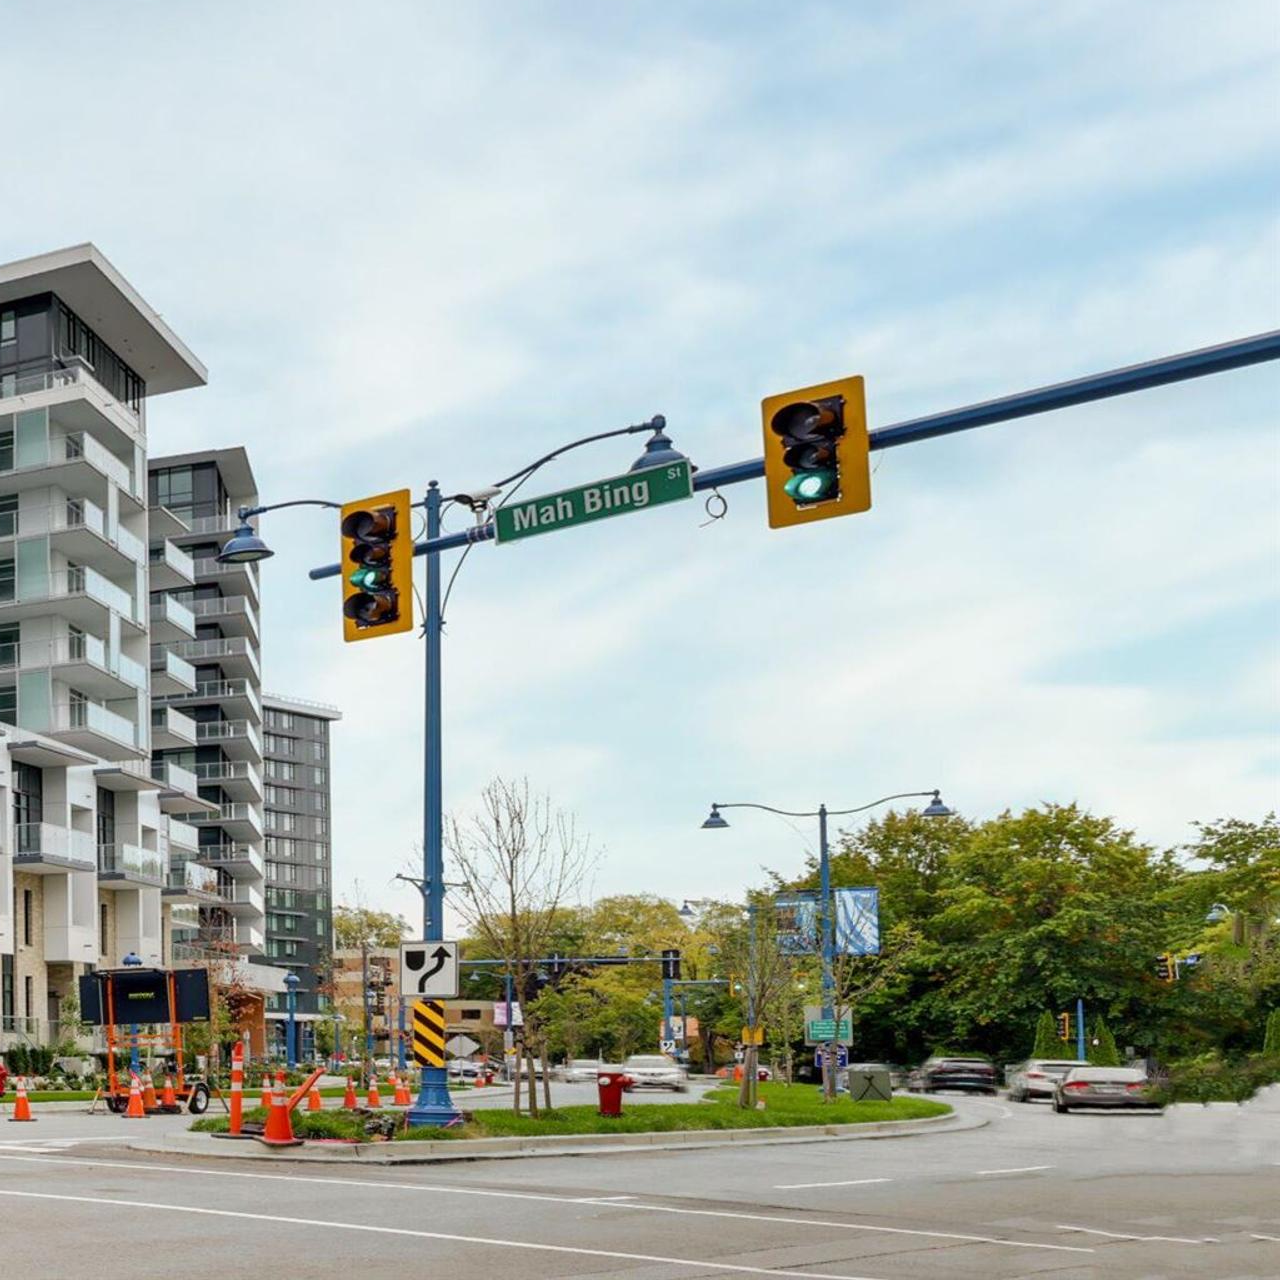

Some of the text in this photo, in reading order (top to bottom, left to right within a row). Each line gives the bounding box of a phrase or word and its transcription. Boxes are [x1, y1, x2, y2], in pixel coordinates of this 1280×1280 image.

[512, 467, 681, 532] Mah Bing St
